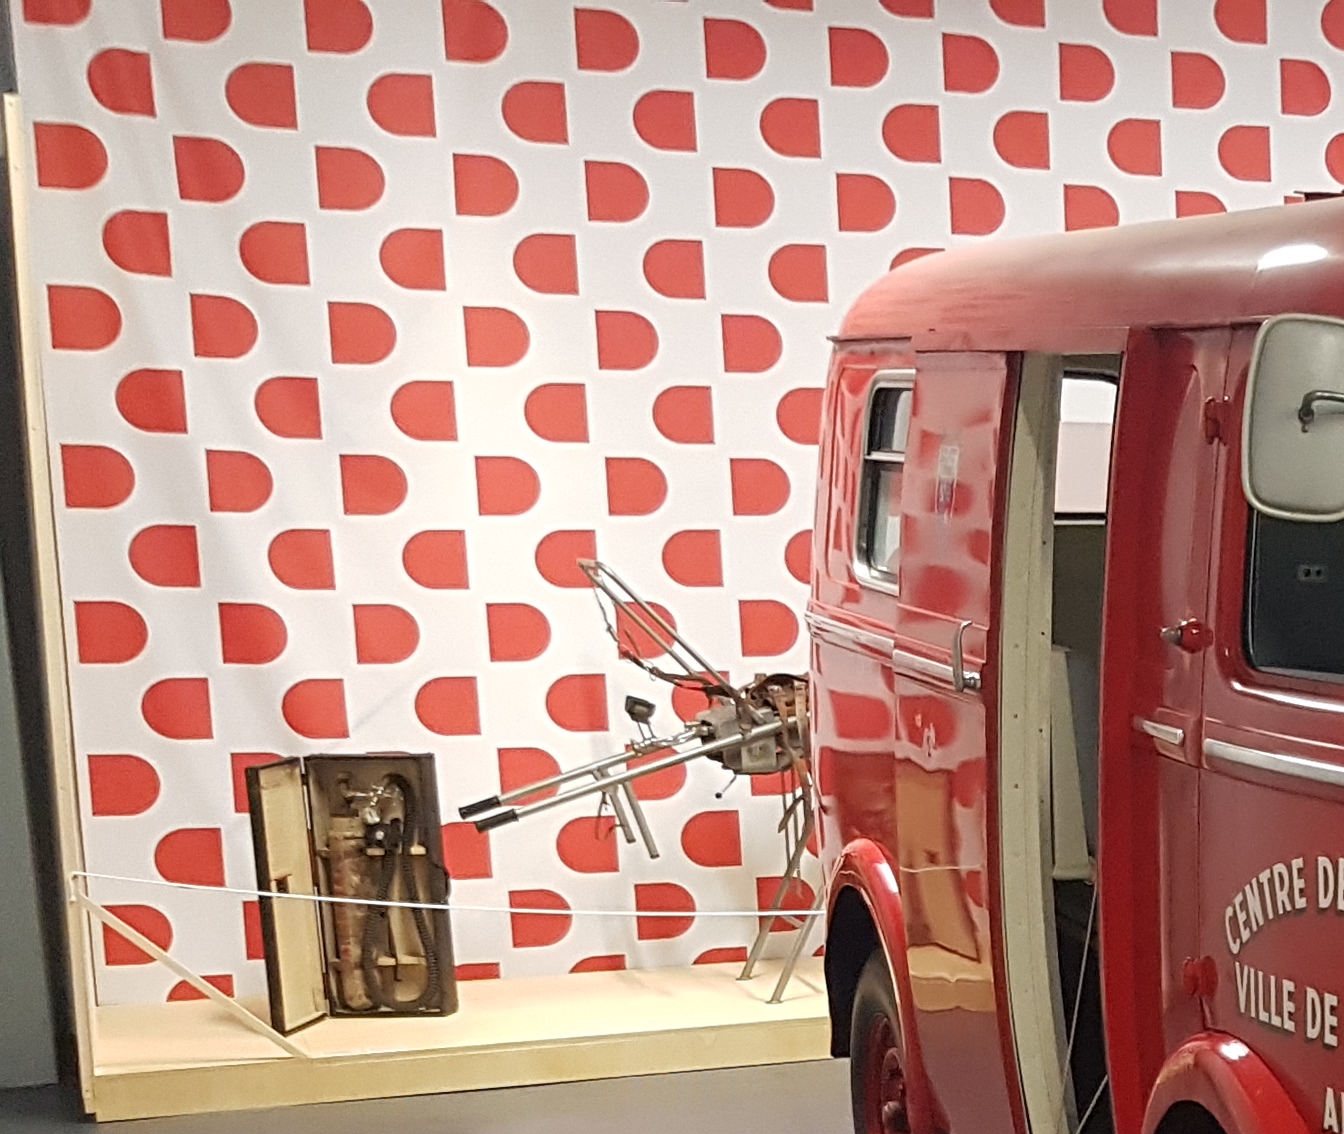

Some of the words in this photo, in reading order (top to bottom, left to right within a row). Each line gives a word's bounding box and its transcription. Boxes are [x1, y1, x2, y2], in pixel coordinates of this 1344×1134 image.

[1224, 856, 1307, 955] CENTRE
[1234, 961, 1297, 1033] VILLE
[1305, 986, 1339, 1048] DE
